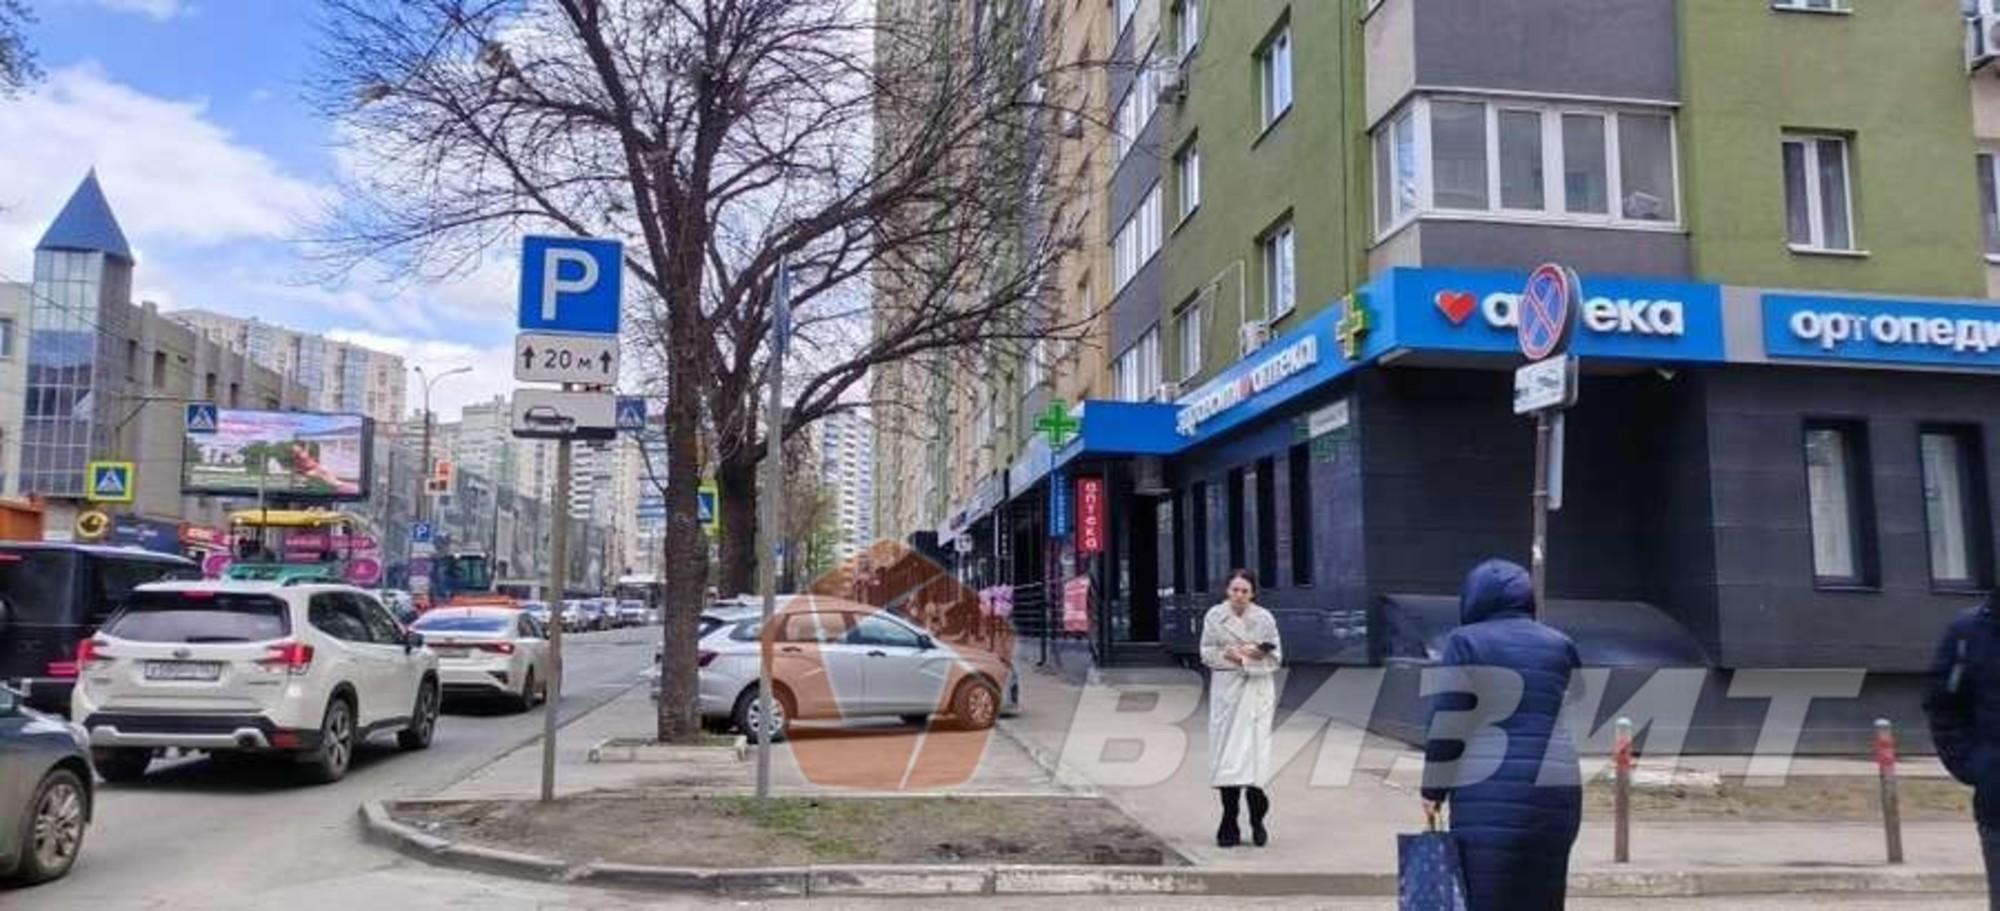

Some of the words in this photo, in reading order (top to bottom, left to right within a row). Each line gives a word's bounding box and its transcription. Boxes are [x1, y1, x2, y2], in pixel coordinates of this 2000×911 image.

[542, 248, 599, 321] P
[1482, 291, 1685, 337] аека
[543, 348, 572, 369] 20
[1084, 481, 1098, 549] аптека
